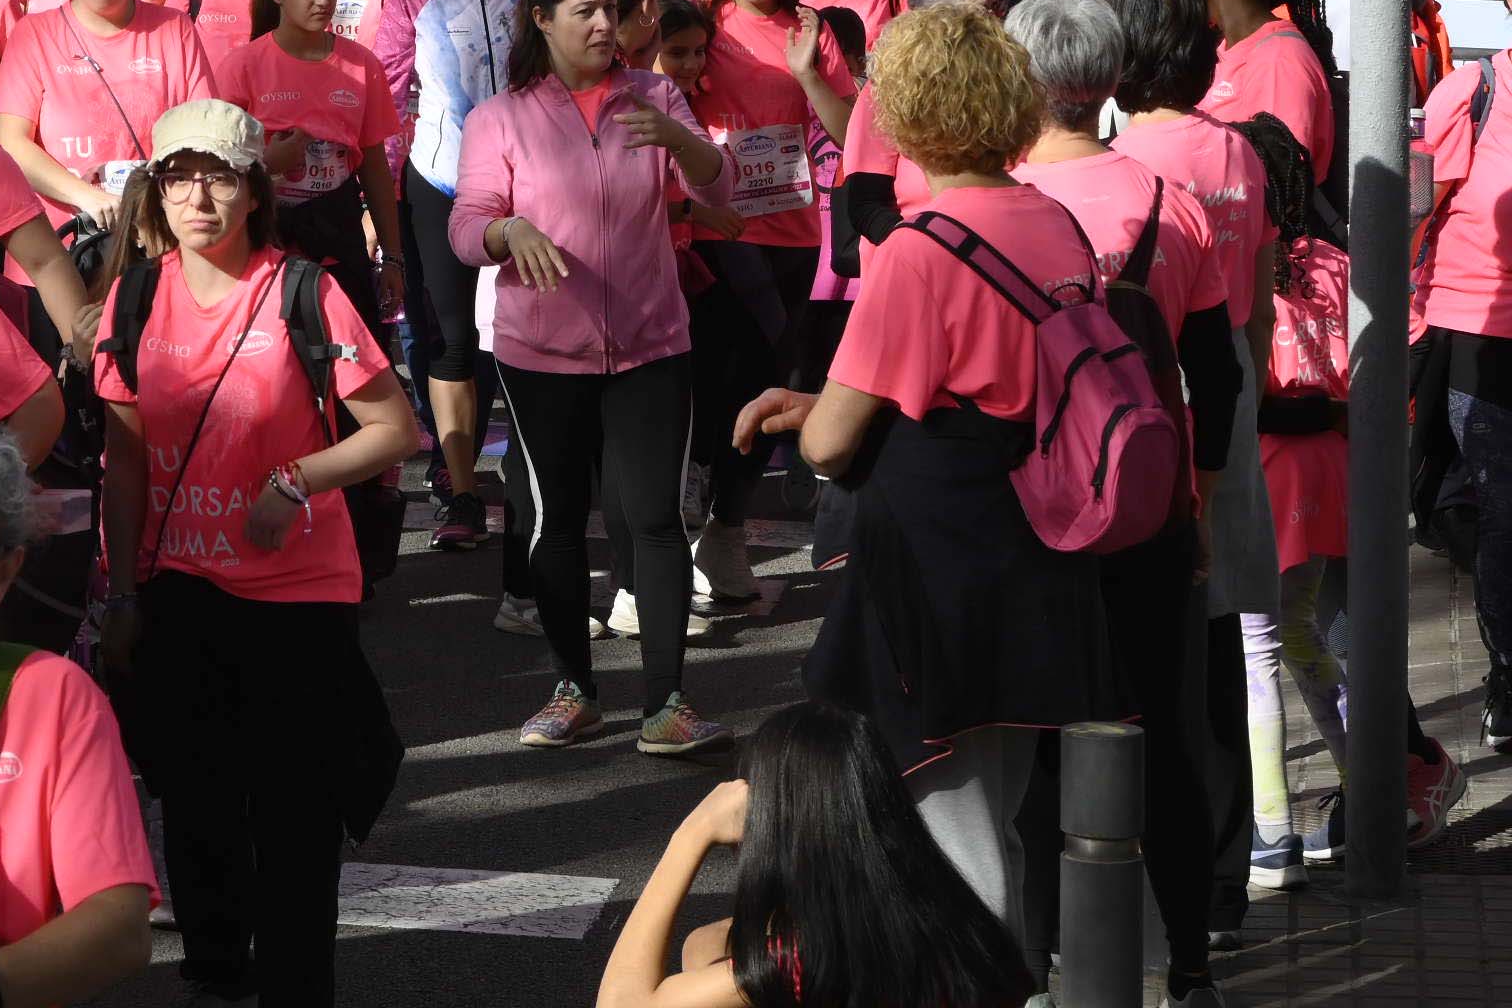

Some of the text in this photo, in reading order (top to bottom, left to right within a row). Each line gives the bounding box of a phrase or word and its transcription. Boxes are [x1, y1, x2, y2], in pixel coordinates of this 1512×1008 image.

[199, 13, 237, 24] OYSHO
[261, 91, 300, 104] OYSHO
[61, 136, 93, 158] TU
[309, 165, 335, 178] 016
[743, 160, 775, 177] 016
[748, 177, 773, 188] 22210
